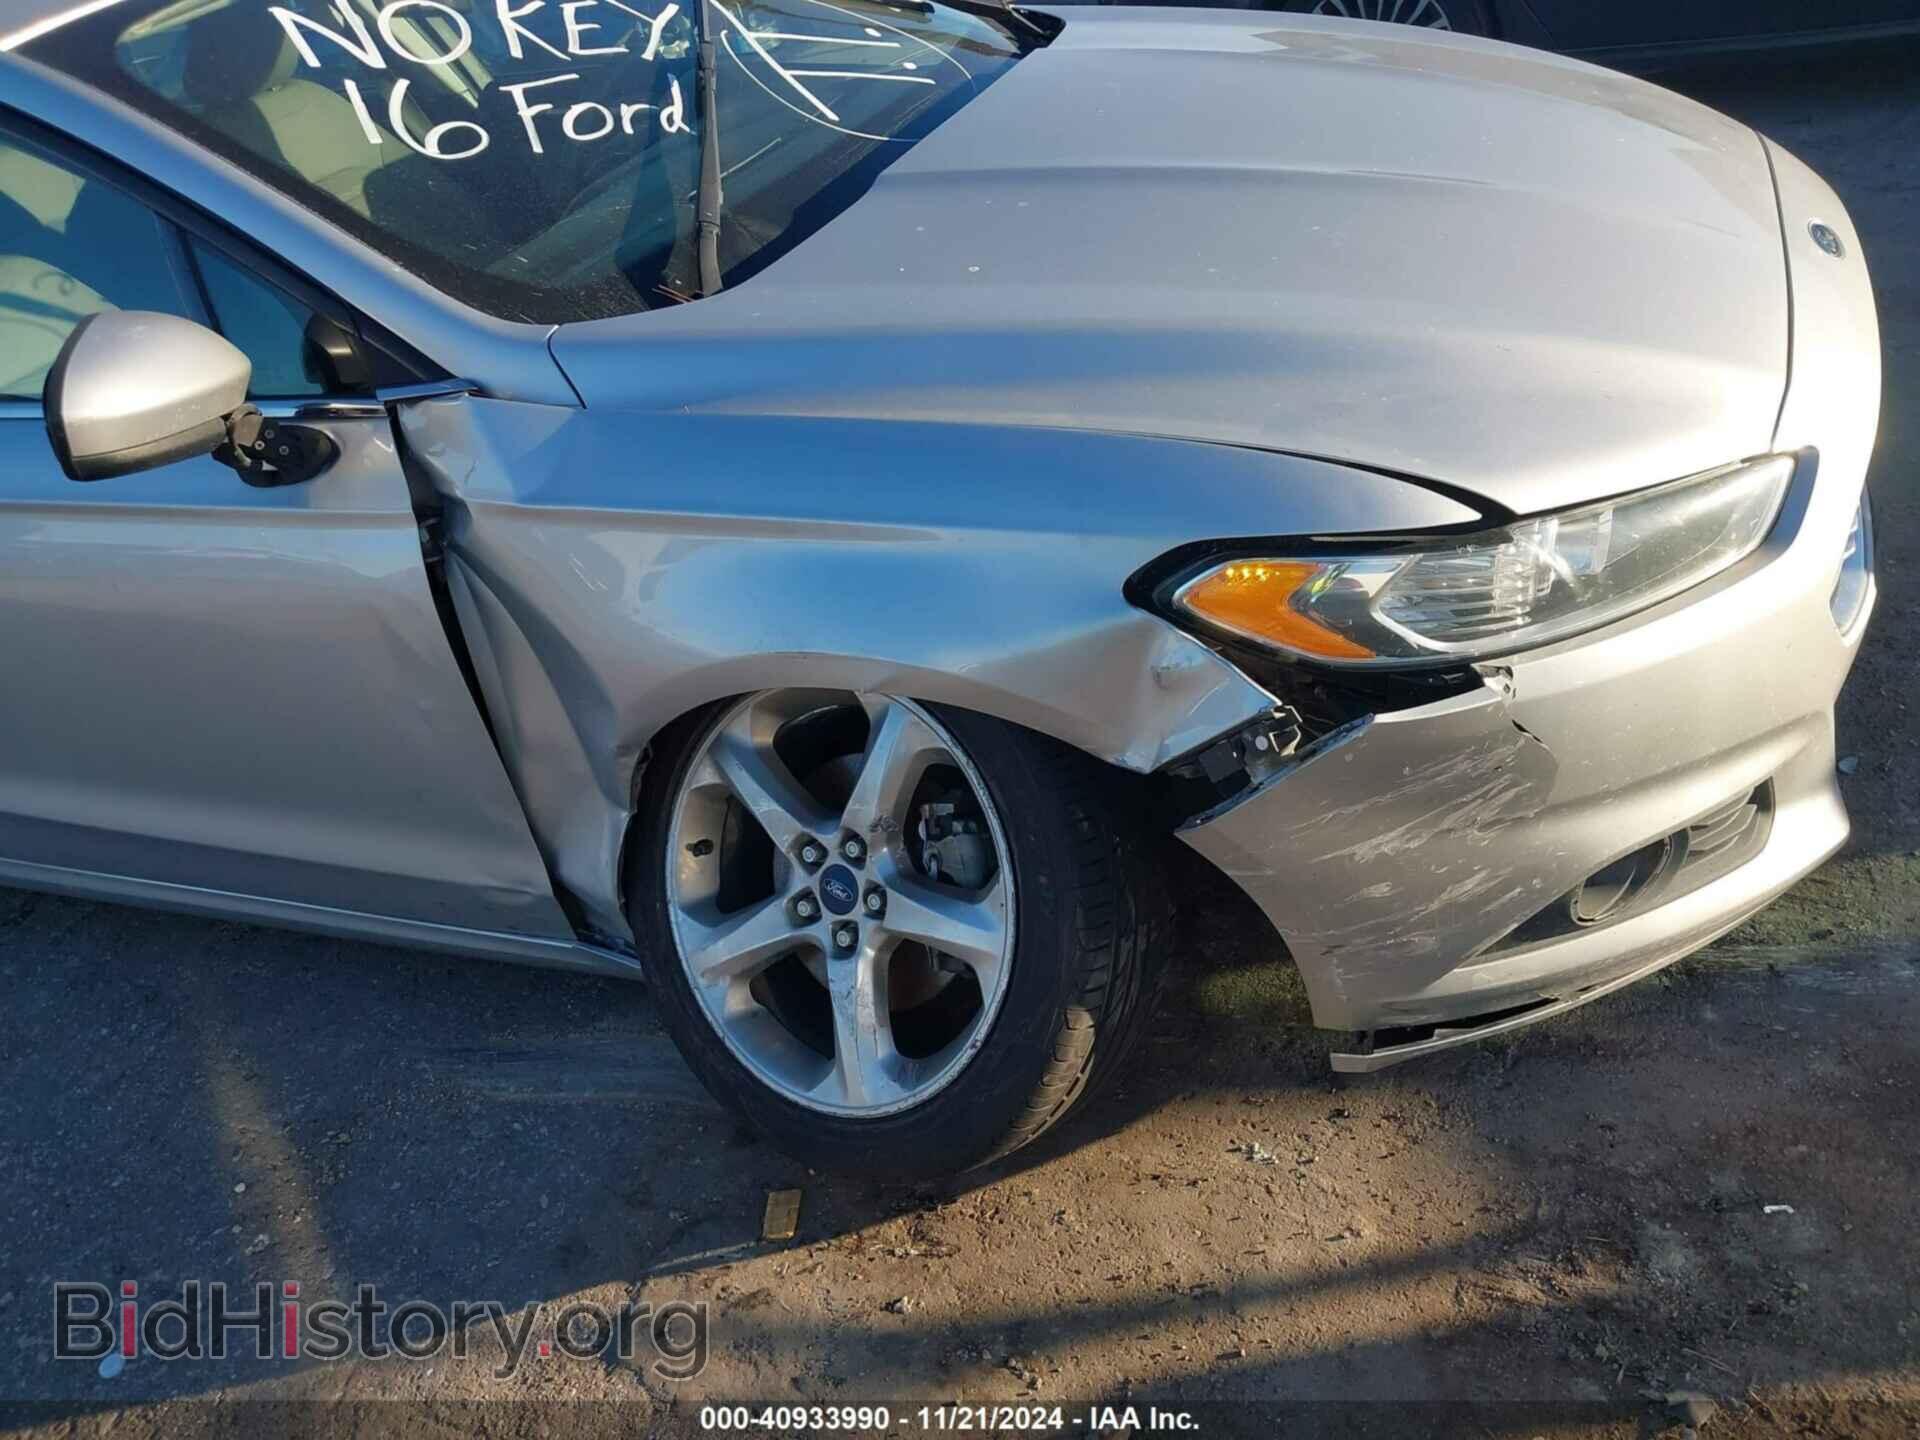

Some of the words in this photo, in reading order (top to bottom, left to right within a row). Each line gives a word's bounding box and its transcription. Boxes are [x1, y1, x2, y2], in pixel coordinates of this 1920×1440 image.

[269, 0, 472, 70] NO
[502, 0, 680, 61] KEY
[344, 78, 491, 161] 16
[499, 73, 696, 155] Ford
